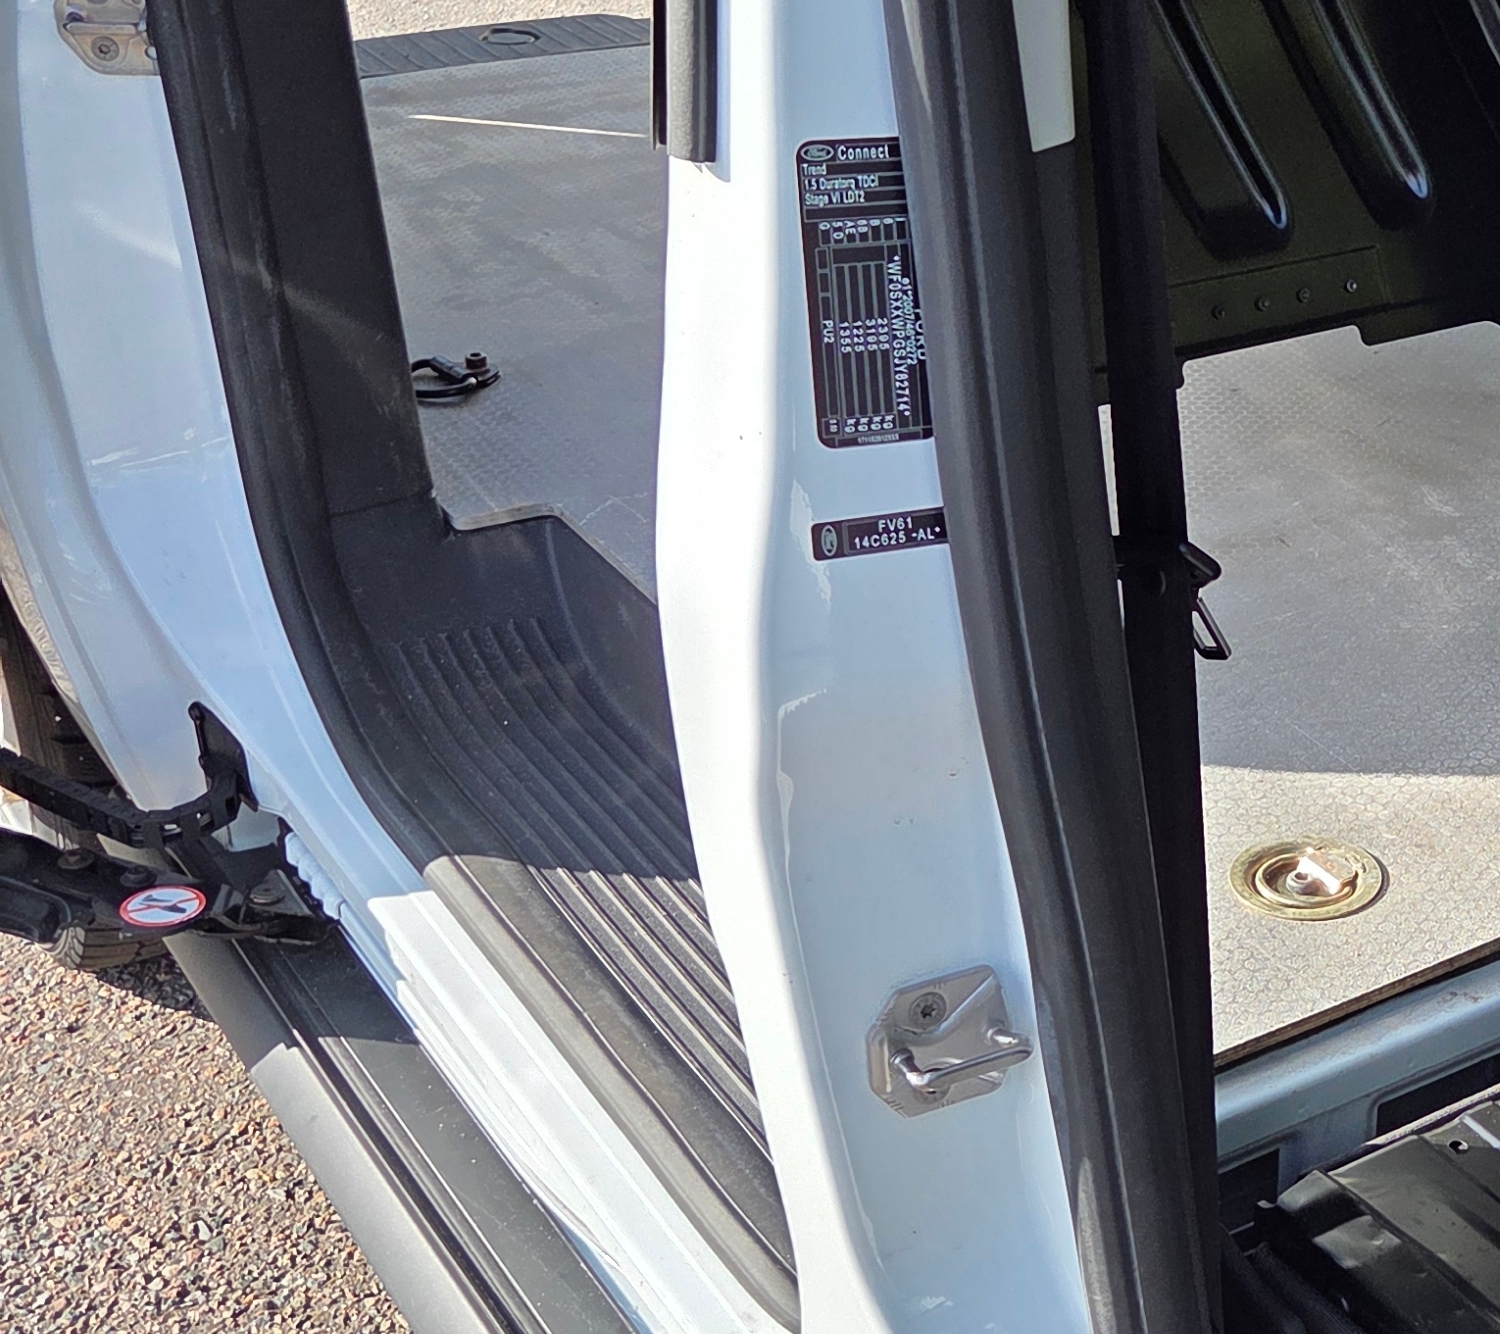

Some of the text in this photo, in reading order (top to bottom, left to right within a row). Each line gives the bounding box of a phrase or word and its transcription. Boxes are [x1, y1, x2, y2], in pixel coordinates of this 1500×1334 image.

[838, 143, 890, 160] Connect
[803, 163, 827, 175] Trend
[804, 178, 817, 191] 1.5
[805, 192, 829, 207] Stage
[830, 191, 841, 204] VI
[844, 220, 857, 235] AE
[822, 320, 835, 344] PU2
[839, 321, 857, 433] 1355 kg
[852, 320, 870, 432] 1225 kg
[870, 416, 883, 430] kg
[883, 414, 895, 429] kg
[878, 516, 912, 532] FV61
[854, 531, 907, 549] 14C625
